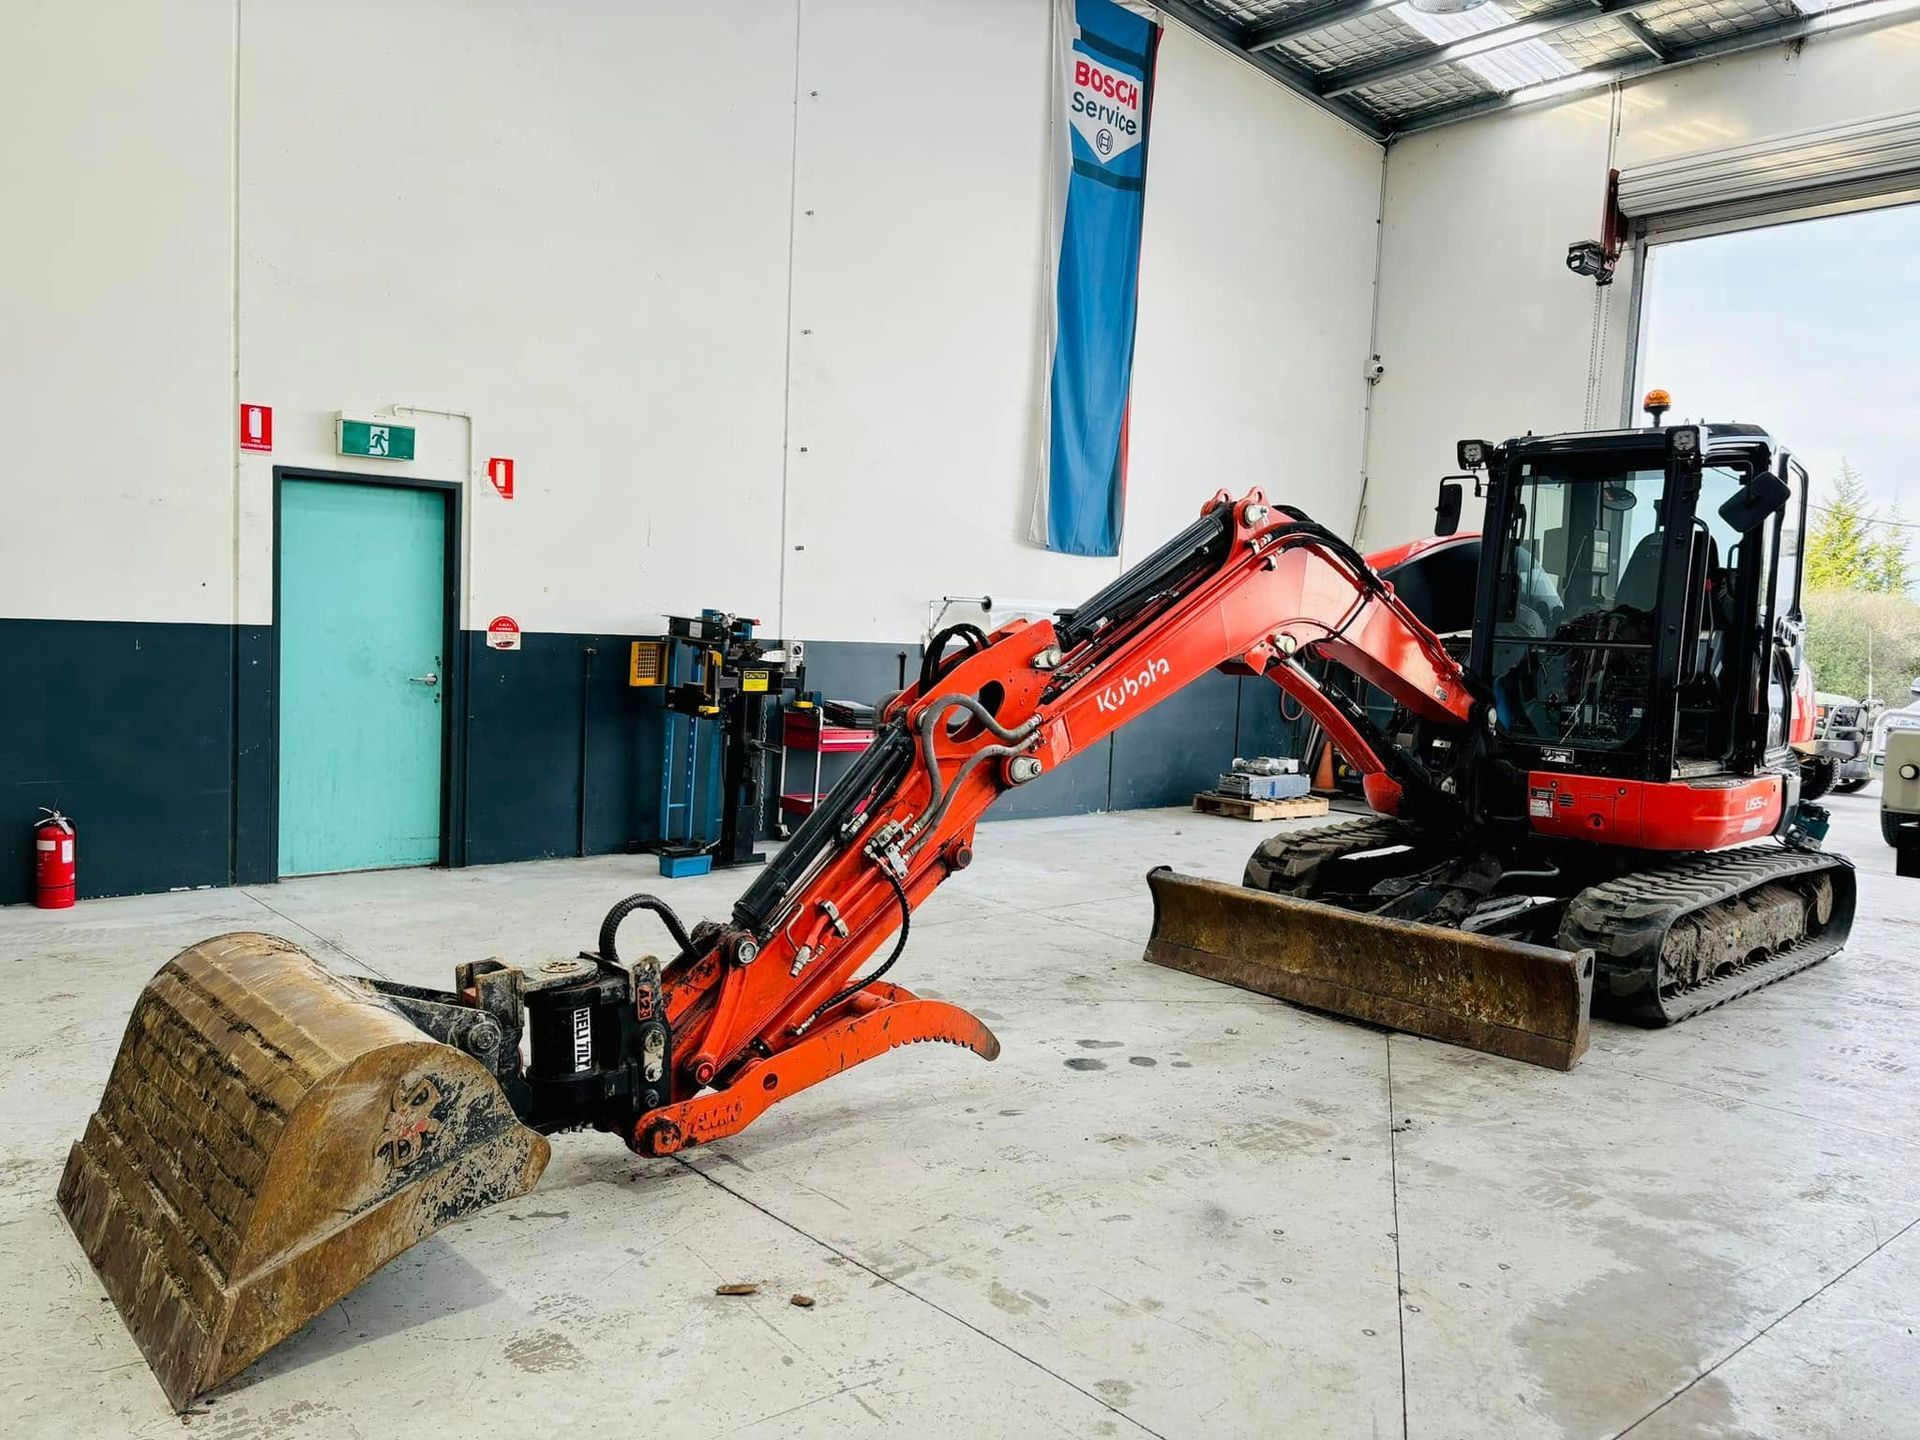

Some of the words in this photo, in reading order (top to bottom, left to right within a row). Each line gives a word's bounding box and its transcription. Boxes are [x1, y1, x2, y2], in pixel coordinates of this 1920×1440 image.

[1075, 61, 1137, 110] BOSCH
[1071, 92, 1137, 135] Service
[1096, 657, 1170, 712] Kubota
